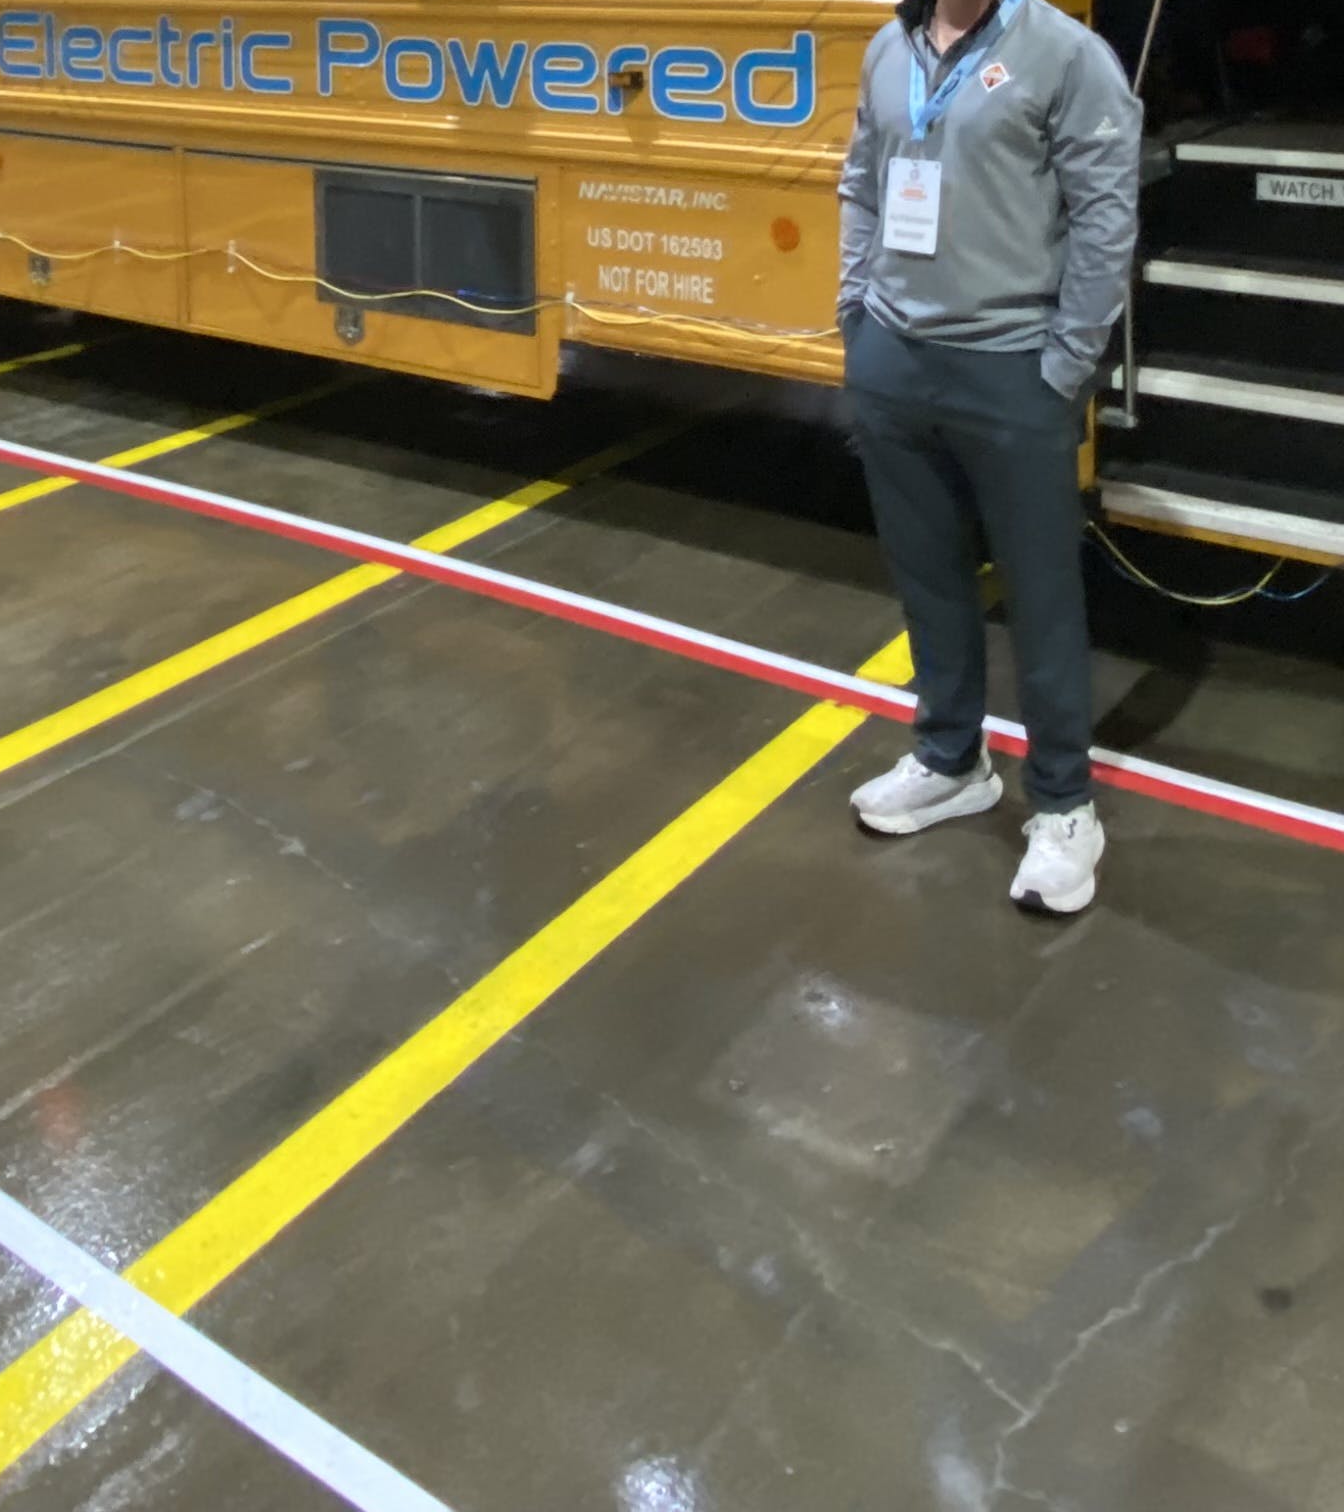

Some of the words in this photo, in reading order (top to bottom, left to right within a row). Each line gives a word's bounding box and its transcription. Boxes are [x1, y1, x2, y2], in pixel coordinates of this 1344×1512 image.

[316, 17, 815, 127] Powered
[1269, 179, 1335, 201] WATCH
[587, 225, 612, 249] US
[616, 230, 655, 254] DOT
[598, 264, 631, 292] NOT
[635, 269, 670, 298] FOR
[673, 273, 714, 304] HIRE
